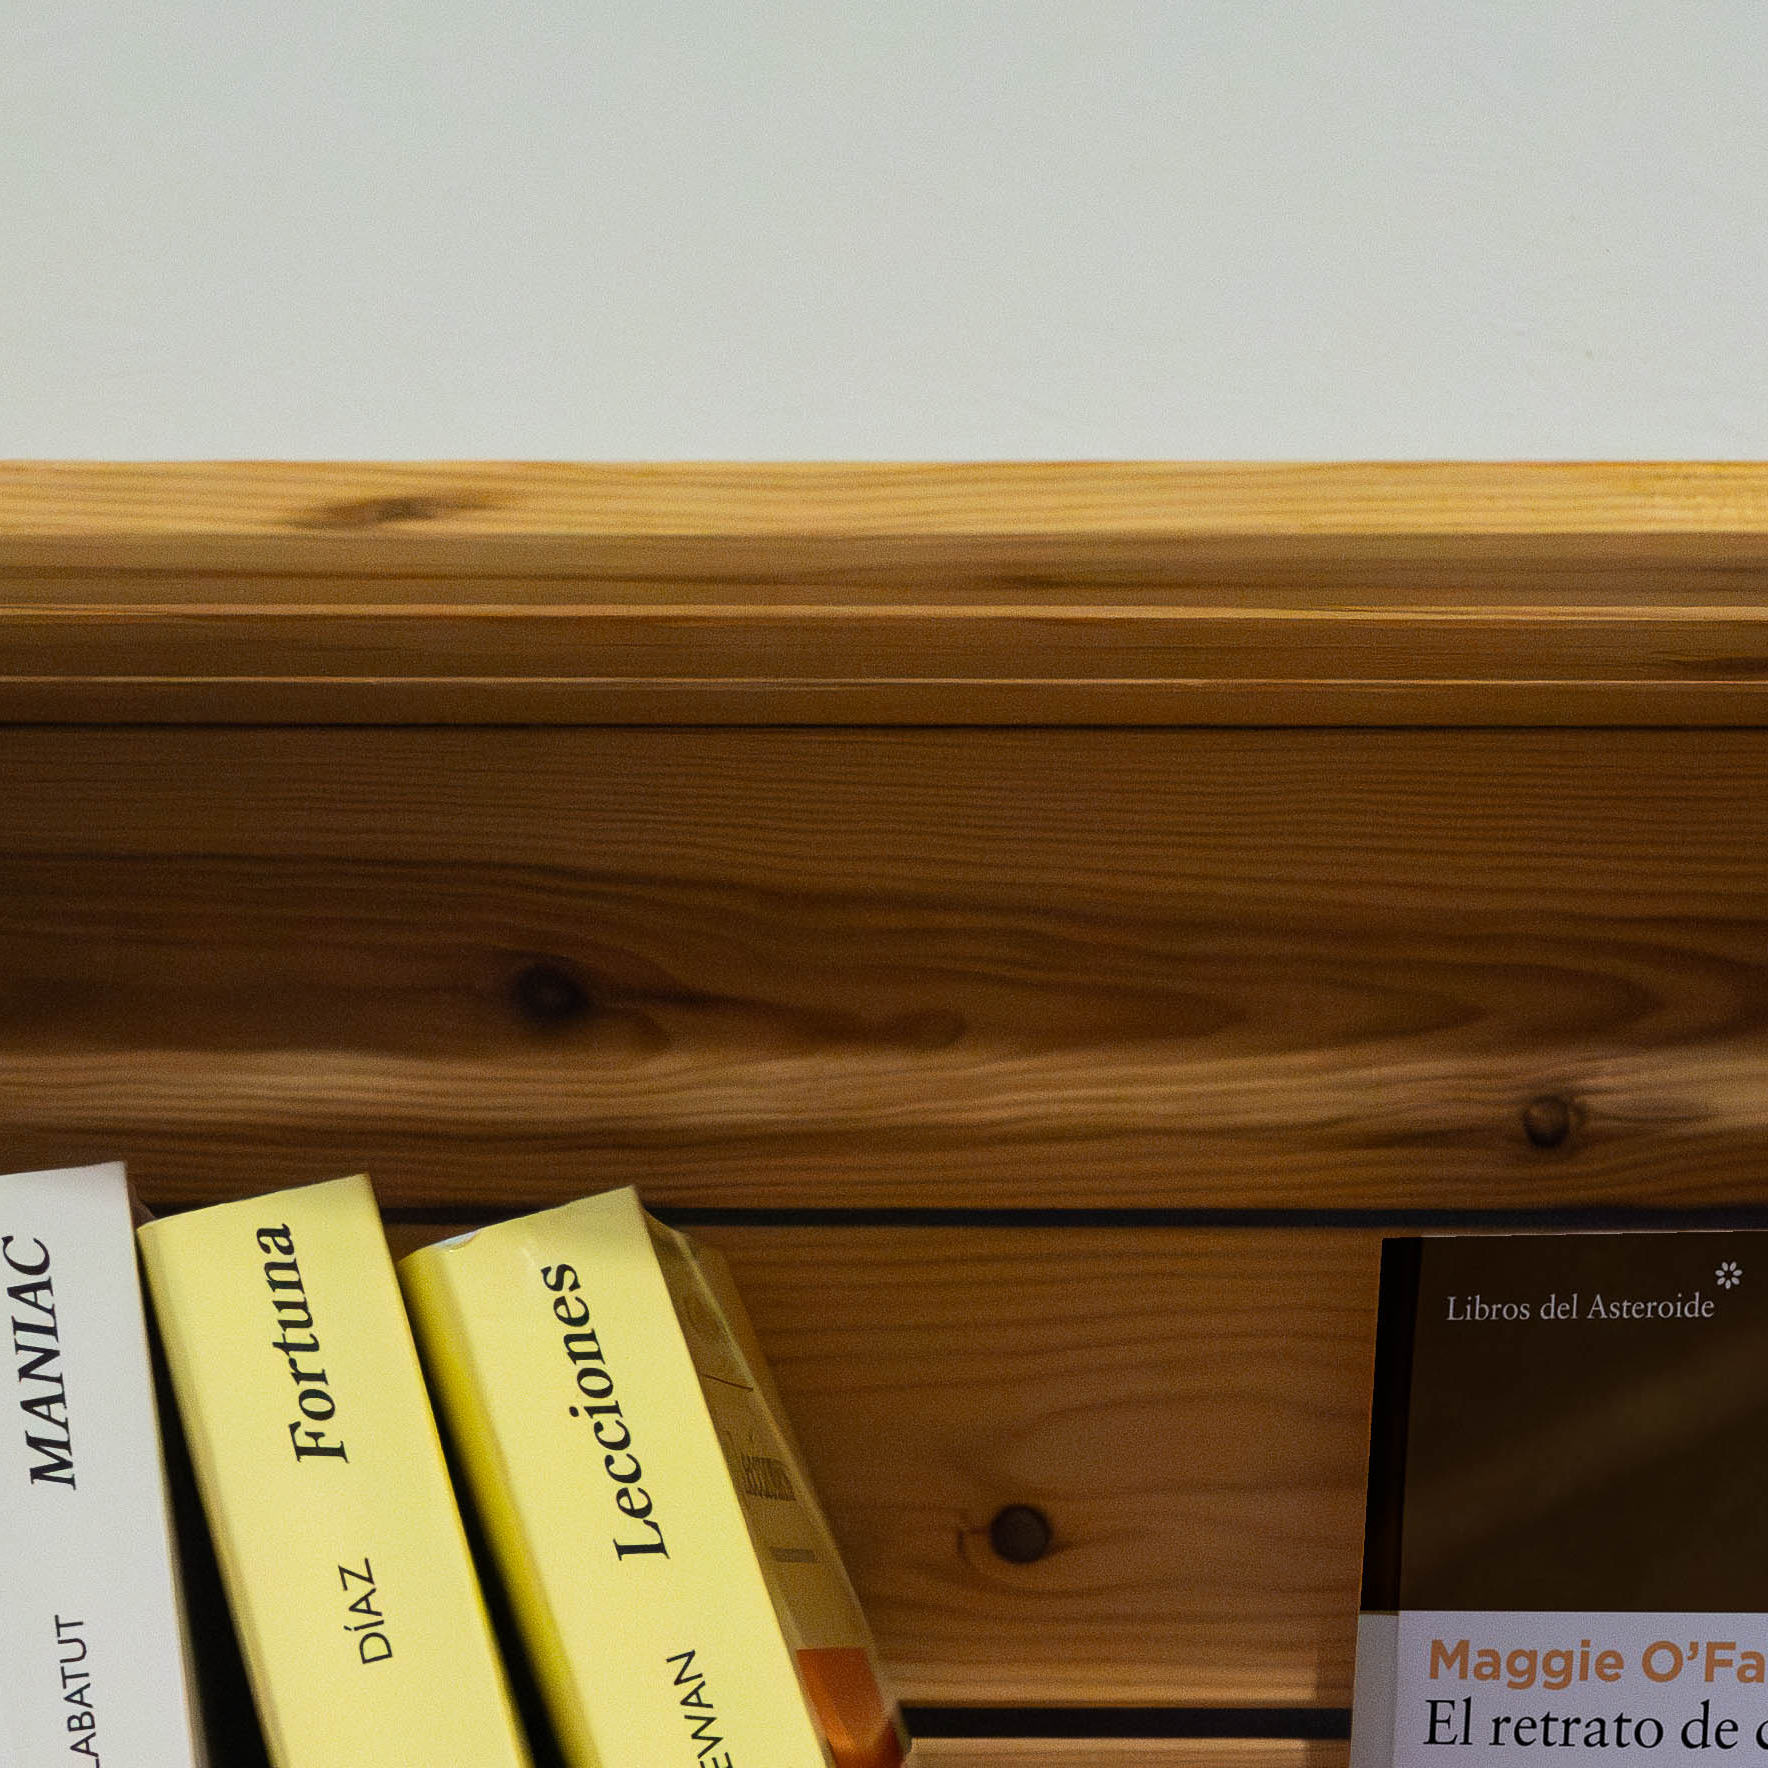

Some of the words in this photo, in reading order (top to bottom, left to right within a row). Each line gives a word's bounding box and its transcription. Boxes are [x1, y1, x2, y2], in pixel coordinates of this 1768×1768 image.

[256, 1223, 349, 1464] Fortuna
[1446, 1294, 1530, 1321] Libros
[1539, 1293, 1578, 1320] del
[1586, 1291, 1715, 1319] Asteroide
[0, 1235, 77, 1491] MANIAC
[540, 1263, 671, 1562] Lecciones
[337, 1557, 393, 1665] DÍAZ
[1428, 1638, 1625, 1691] Maggie
[1422, 1696, 1473, 1746] El
[1488, 1711, 1664, 1749] retrato
[1680, 1698, 1739, 1750] de
